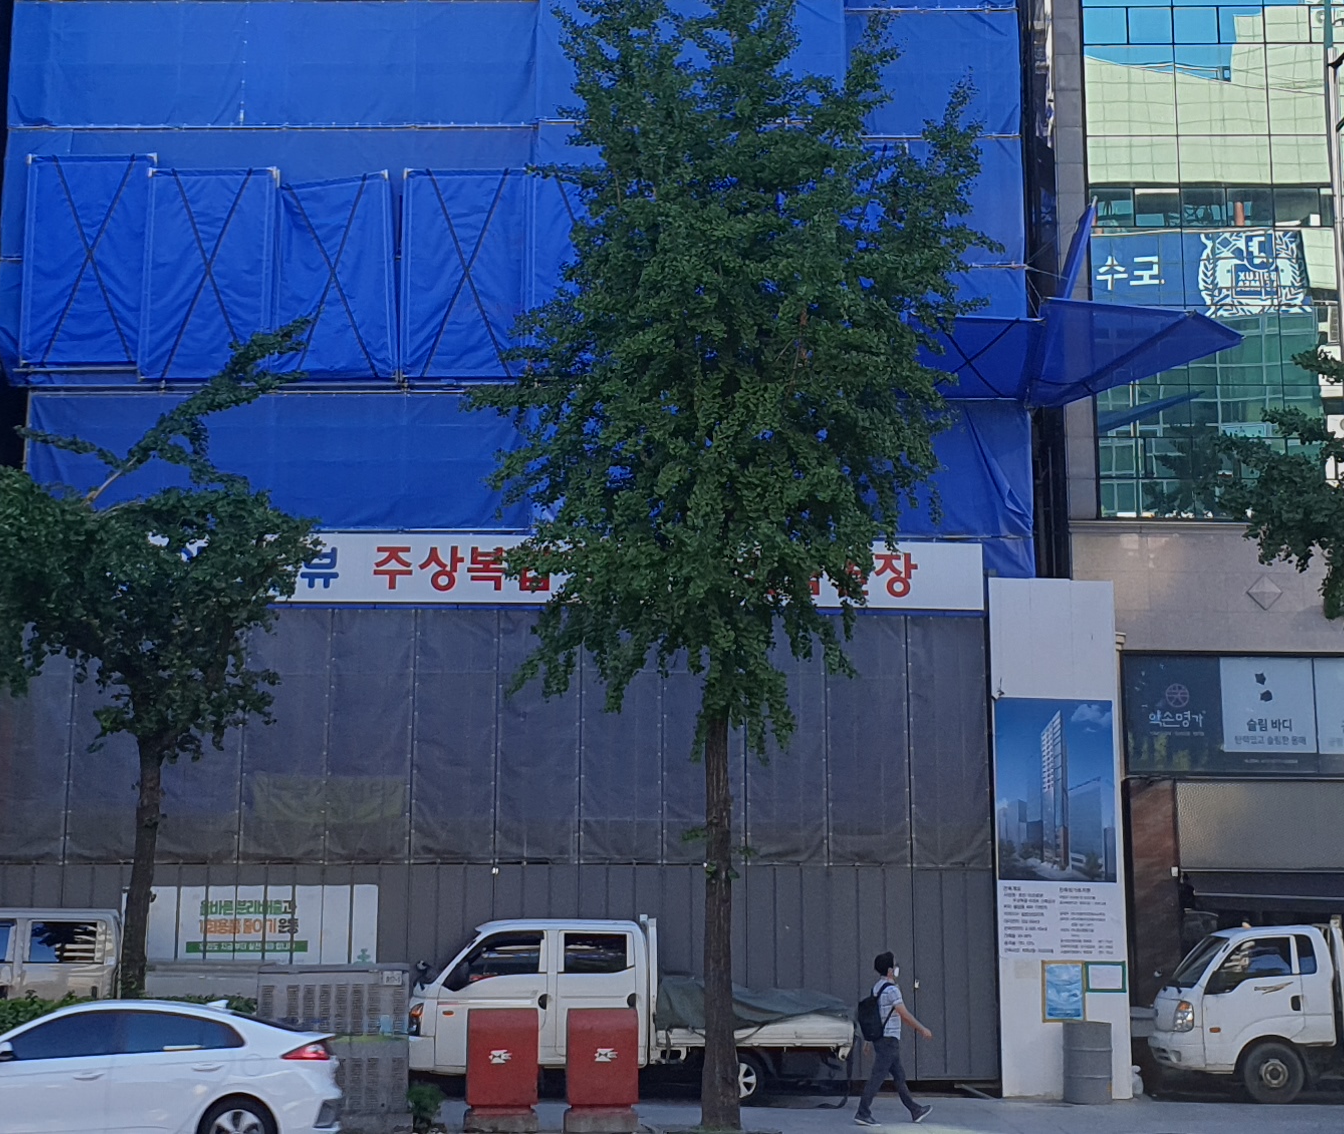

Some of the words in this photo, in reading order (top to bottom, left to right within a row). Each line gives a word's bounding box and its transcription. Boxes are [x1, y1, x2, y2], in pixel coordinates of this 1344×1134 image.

[1148, 709, 1204, 728] 약손명가
[1246, 718, 1268, 732] 슬림
[1270, 718, 1293, 733] 바디
